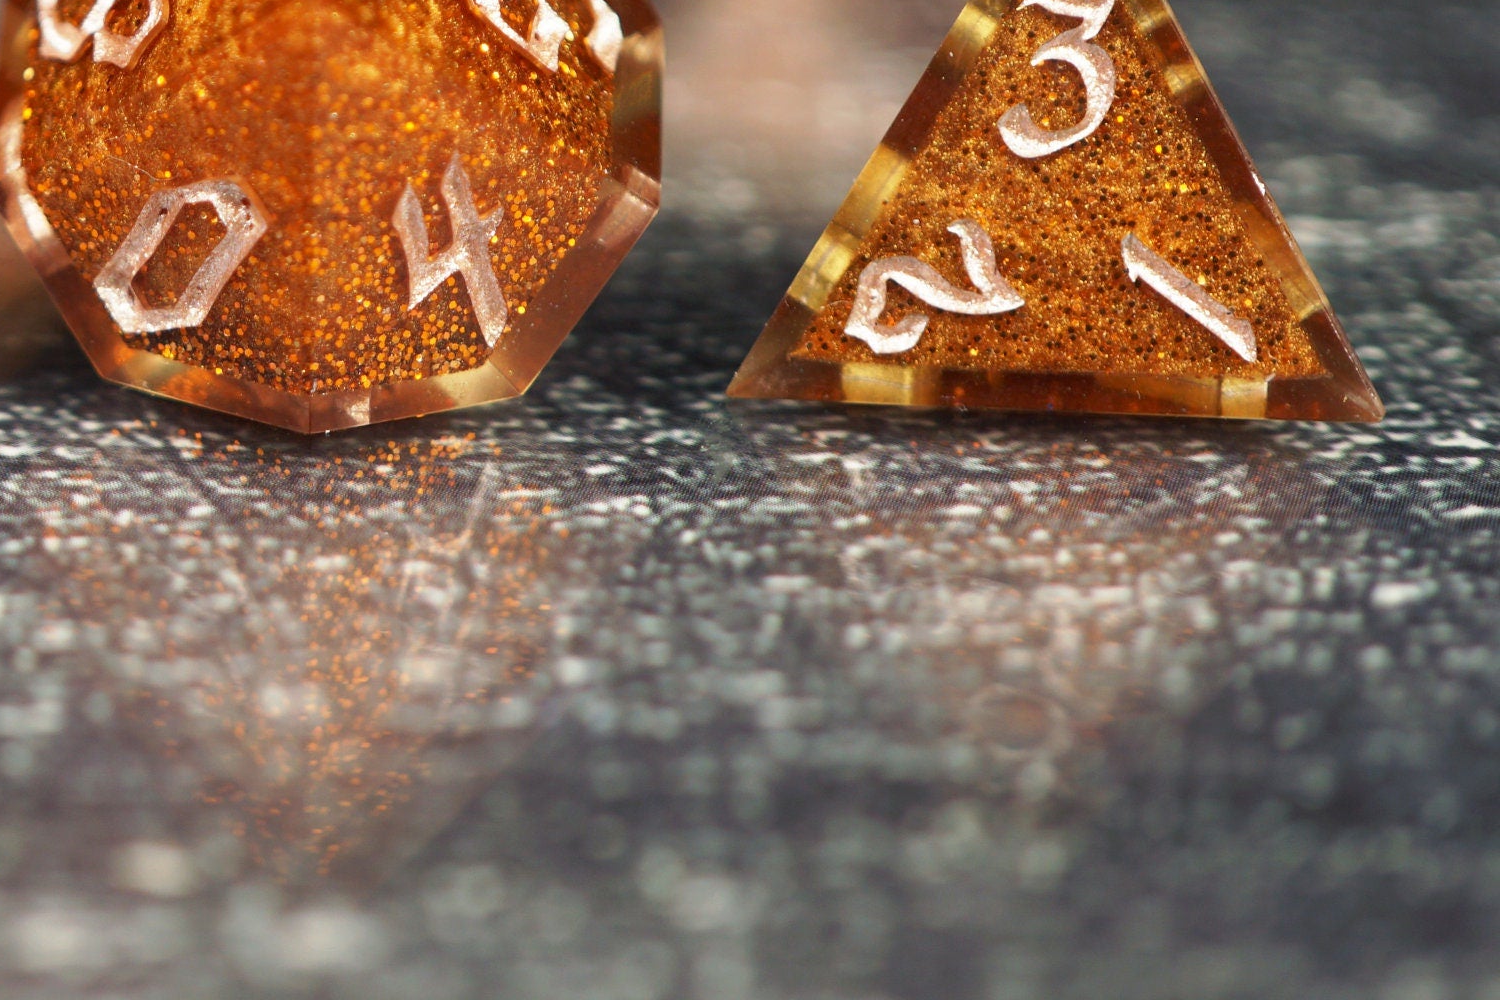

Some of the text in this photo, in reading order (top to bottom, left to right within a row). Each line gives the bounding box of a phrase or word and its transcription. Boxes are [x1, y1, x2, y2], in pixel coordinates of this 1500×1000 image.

[94, 176, 267, 333] 0
[393, 152, 507, 349] 4
[844, 219, 1025, 354] 2
[1120, 232, 1257, 362] 1
